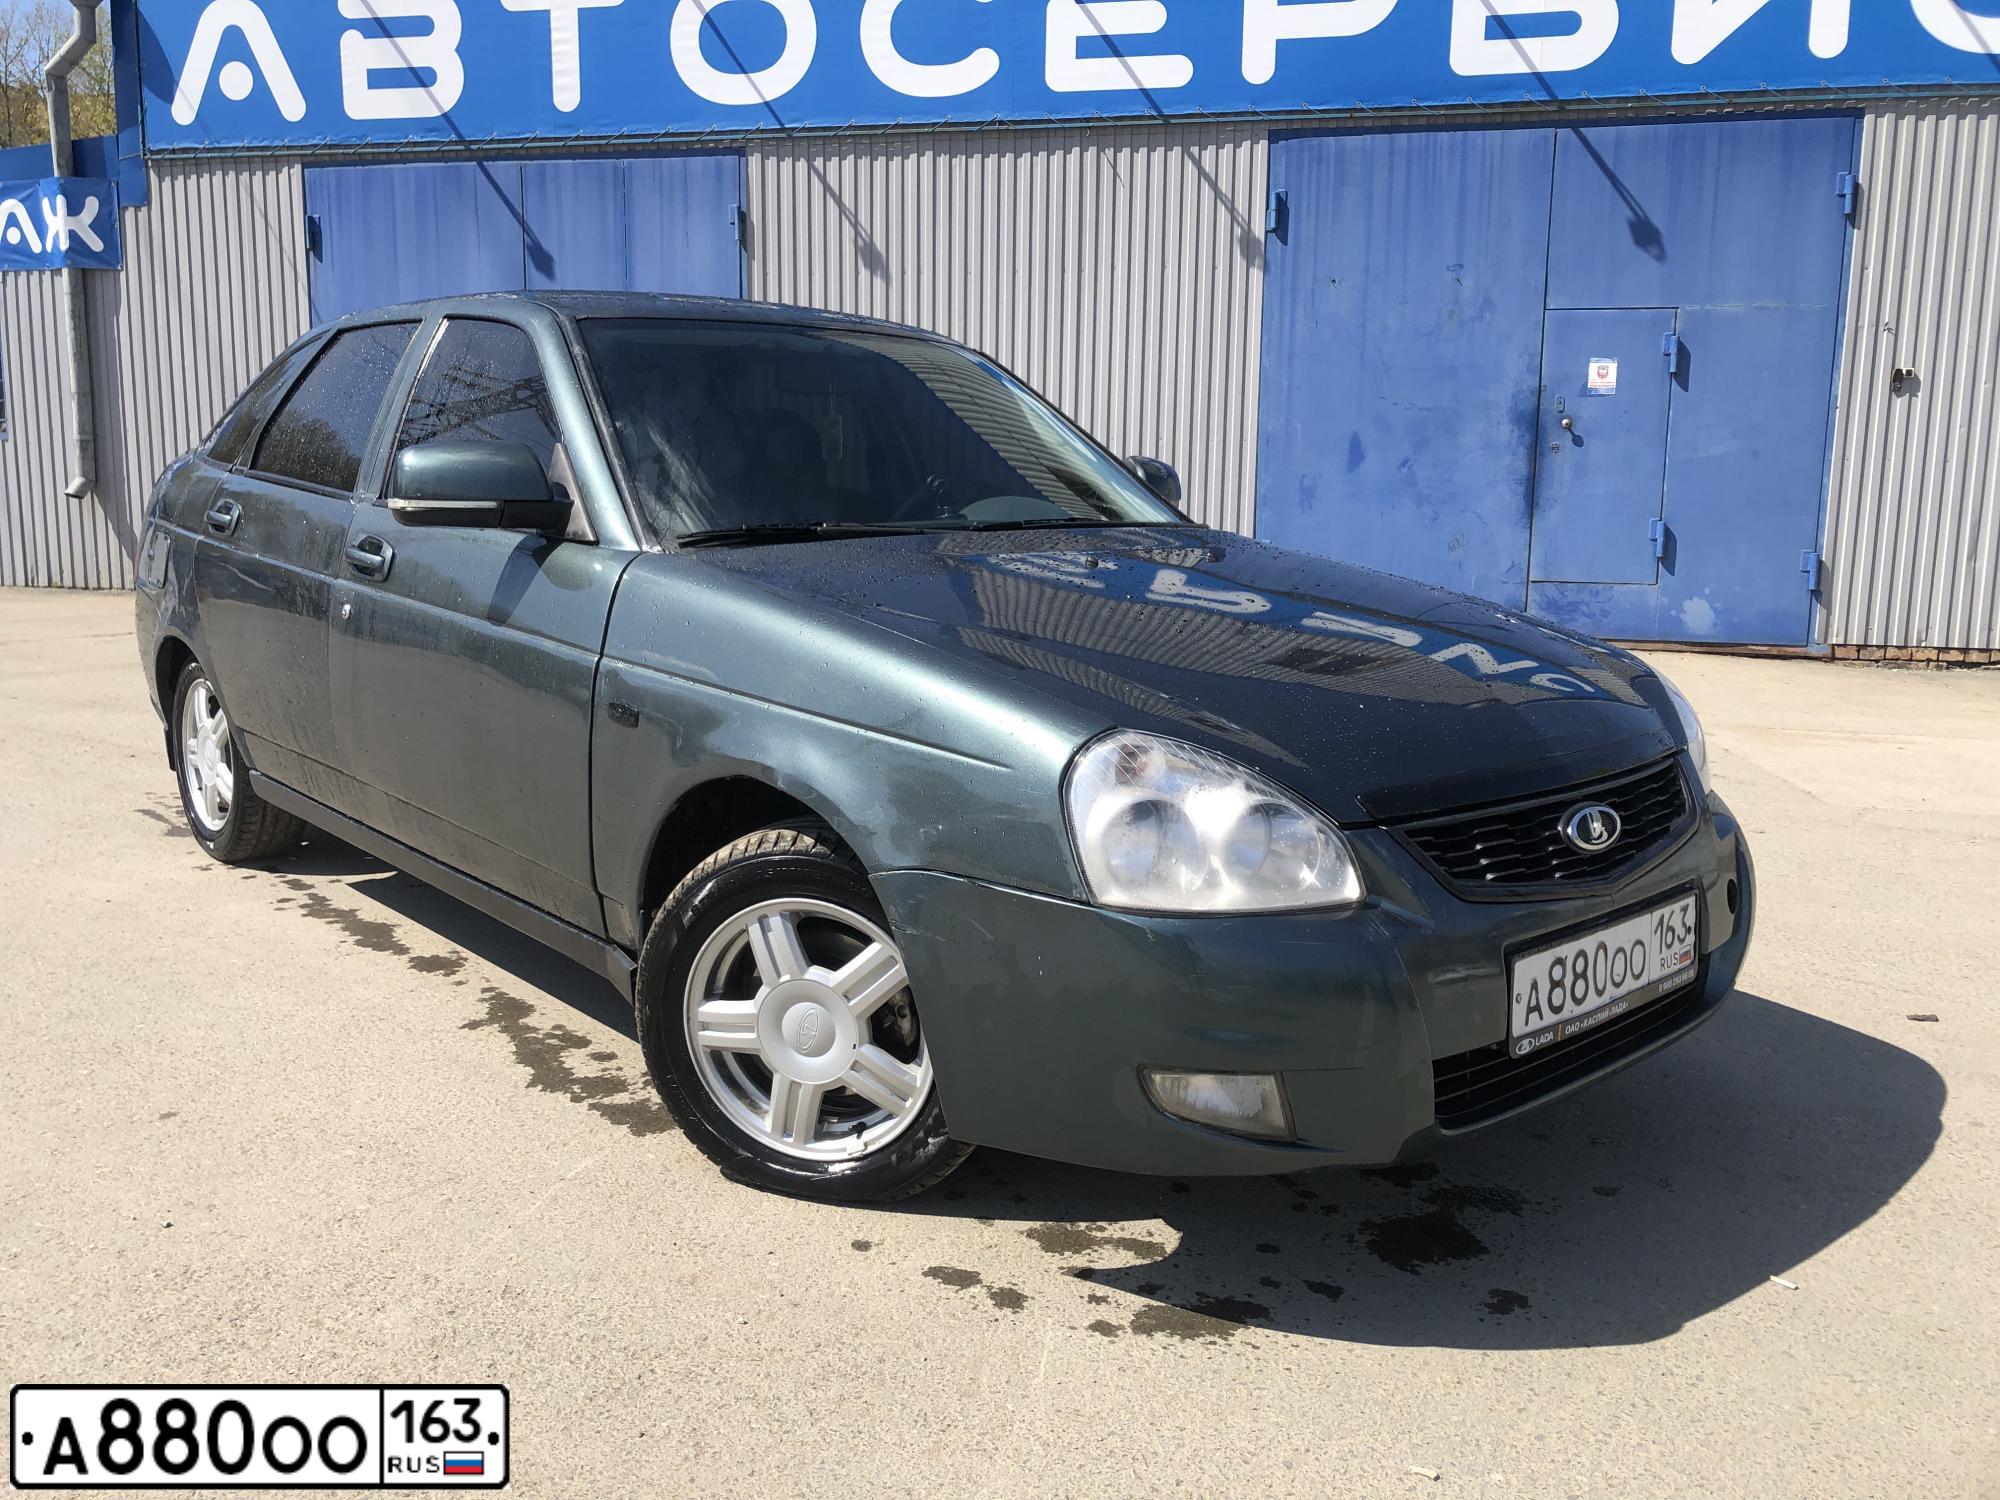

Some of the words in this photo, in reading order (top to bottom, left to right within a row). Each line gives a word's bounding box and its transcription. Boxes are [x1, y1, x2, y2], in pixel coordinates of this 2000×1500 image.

[171, 0, 2000, 125] АВТОСЕРВ
[1654, 903, 1690, 955] 163
[1660, 952, 1679, 972] RUS
[1535, 1031, 1554, 1046] LADA
[1565, 1022, 1580, 1035] ОАО
